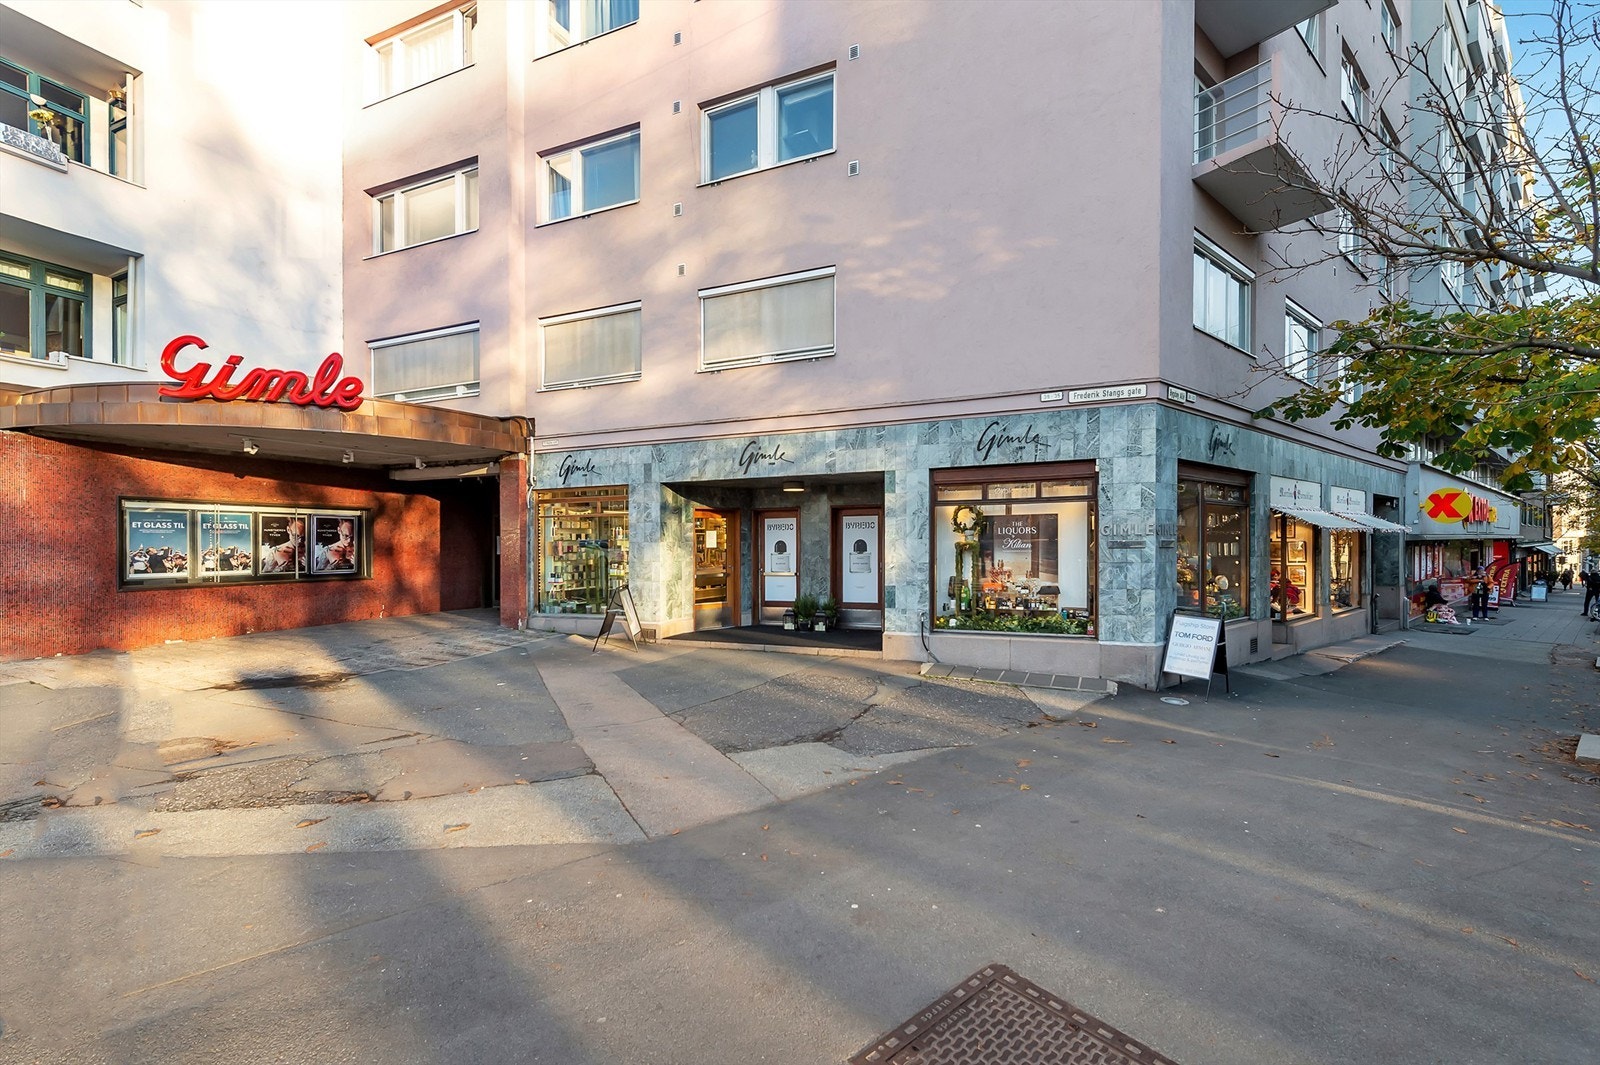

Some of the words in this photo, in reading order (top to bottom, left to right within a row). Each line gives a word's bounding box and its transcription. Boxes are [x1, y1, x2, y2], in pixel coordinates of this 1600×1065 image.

[159, 335, 364, 412] Gimle
[1073, 390, 1100, 400] Frederik
[1102, 389, 1125, 397] Stangs
[1127, 387, 1142, 396] gate
[977, 421, 1052, 461] Gimle
[739, 440, 794, 475] Gimle
[559, 455, 602, 485] Gimle
[767, 523, 794, 531] BYREDO
[845, 521, 875, 530] BYREDO
[998, 526, 1037, 535] LIQUORS
[1100, 523, 1155, 537] GIMLE
[1002, 538, 1032, 549] Kilian
[1501, 568, 1511, 588] EXTRA
[1174, 630, 1191, 639] TOM
[1191, 633, 1214, 642] FORD
